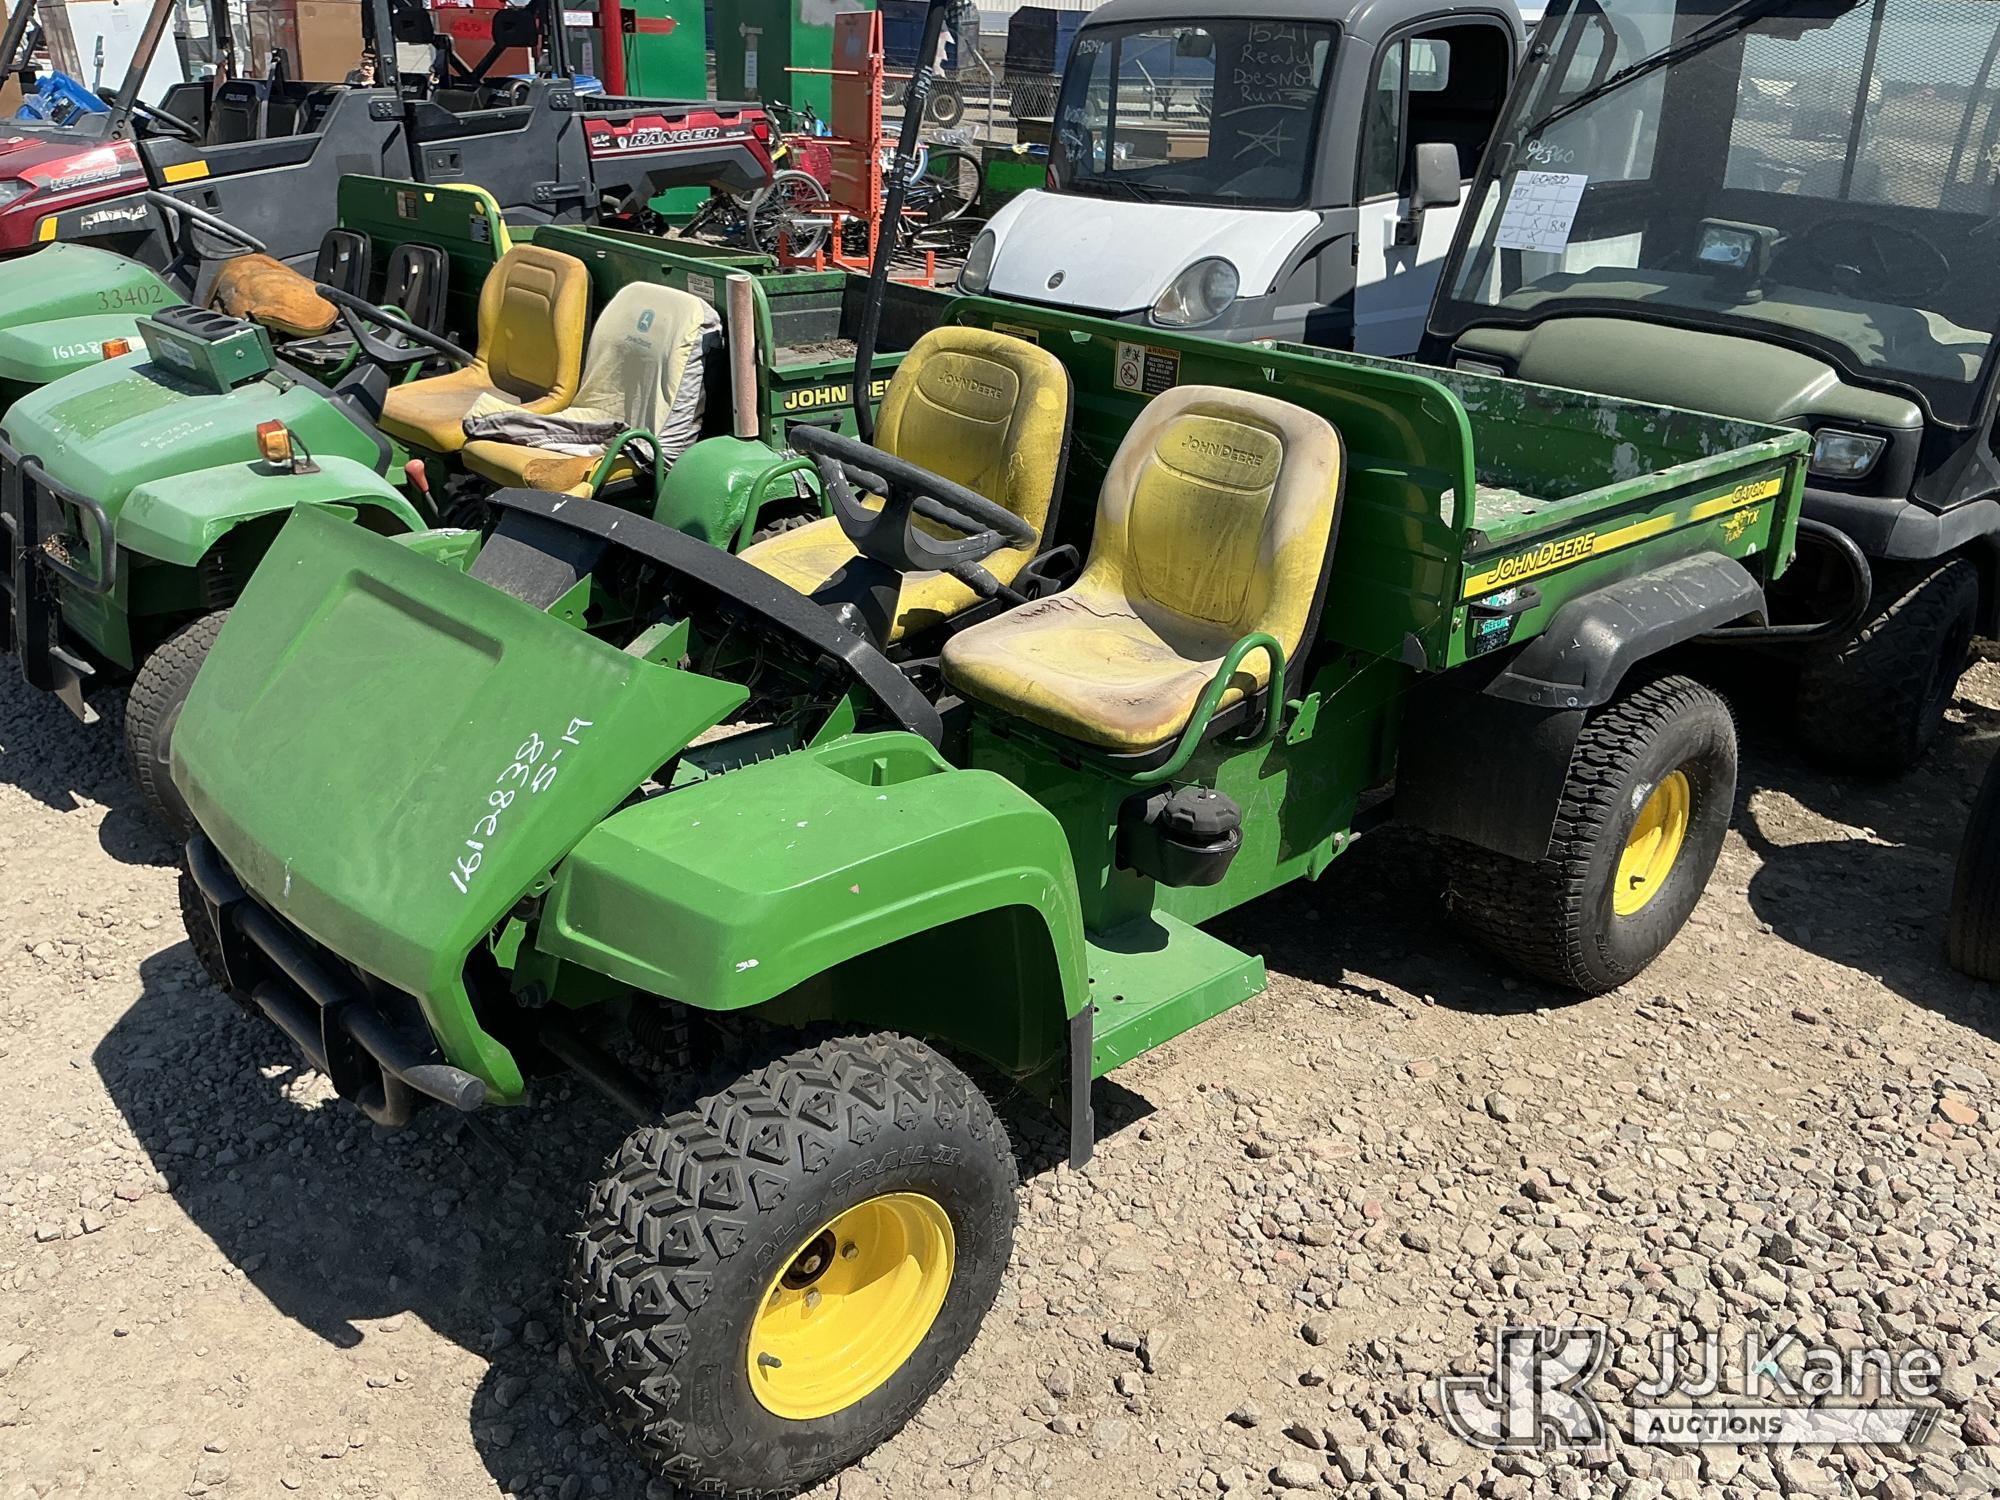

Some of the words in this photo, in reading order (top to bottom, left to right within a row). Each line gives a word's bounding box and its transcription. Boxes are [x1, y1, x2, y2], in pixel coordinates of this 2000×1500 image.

[1240, 43, 1313, 69] Ready
[629, 127, 719, 147] RANGER
[96, 285, 163, 311] 33402
[52, 341, 101, 361] 16128
[783, 385, 848, 411] JOHN
[938, 370, 968, 389] JOHN
[968, 379, 1003, 400] DEERE
[1181, 435, 1220, 457] JOHN
[1220, 444, 1264, 468] DEERE
[1732, 480, 1767, 505] GATOR
[1747, 509, 1760, 525] TX
[1487, 552, 1543, 584] JOHN
[1538, 532, 1597, 568] DEERE
[530, 717, 594, 794] 5-19
[449, 732, 545, 894] 1612838
[753, 1201, 818, 1274] ALL
[831, 1145, 929, 1197] TRAIL
